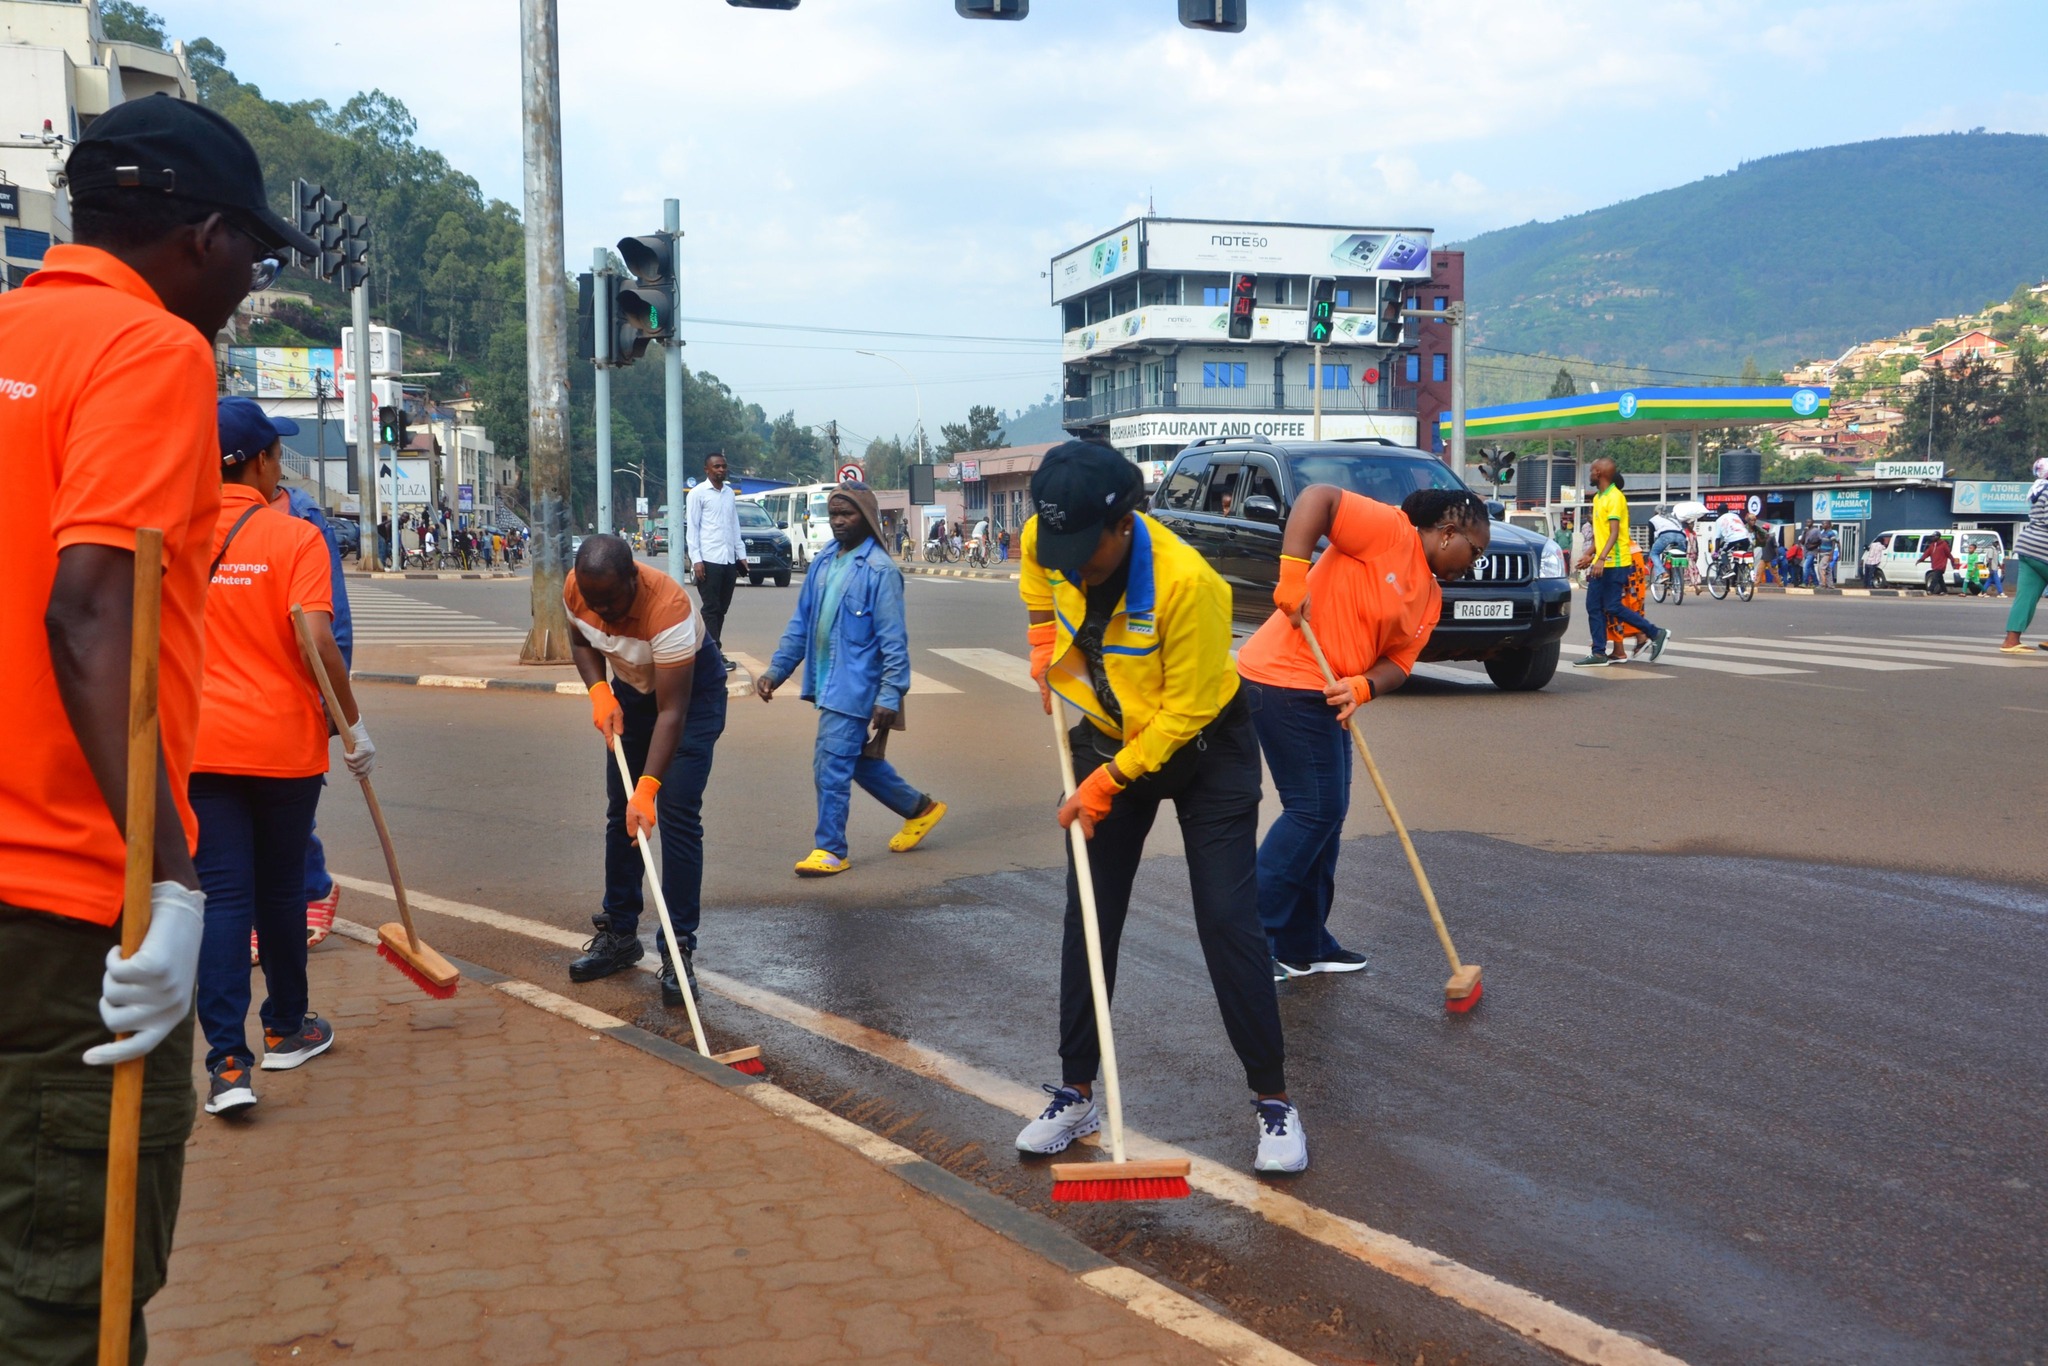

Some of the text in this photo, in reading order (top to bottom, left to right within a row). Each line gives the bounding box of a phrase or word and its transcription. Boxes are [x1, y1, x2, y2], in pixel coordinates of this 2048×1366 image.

[0, 377, 38, 400] ngo
[1795, 393, 1815, 411] SP
[1138, 421, 1217, 437] RESTAURANT
[1220, 422, 1251, 436] AND
[1254, 422, 1305, 436] COFFEE
[1888, 465, 1942, 476] PHARMACY
[397, 484, 427, 496] PLAZA
[1990, 484, 2020, 493] ATONE
[1837, 491, 1860, 499] ATONE
[1831, 499, 1869, 508] PHARMACY
[1462, 604, 1482, 617] RAG
[1483, 604, 1502, 617] 087
[1504, 604, 1510, 617] E
